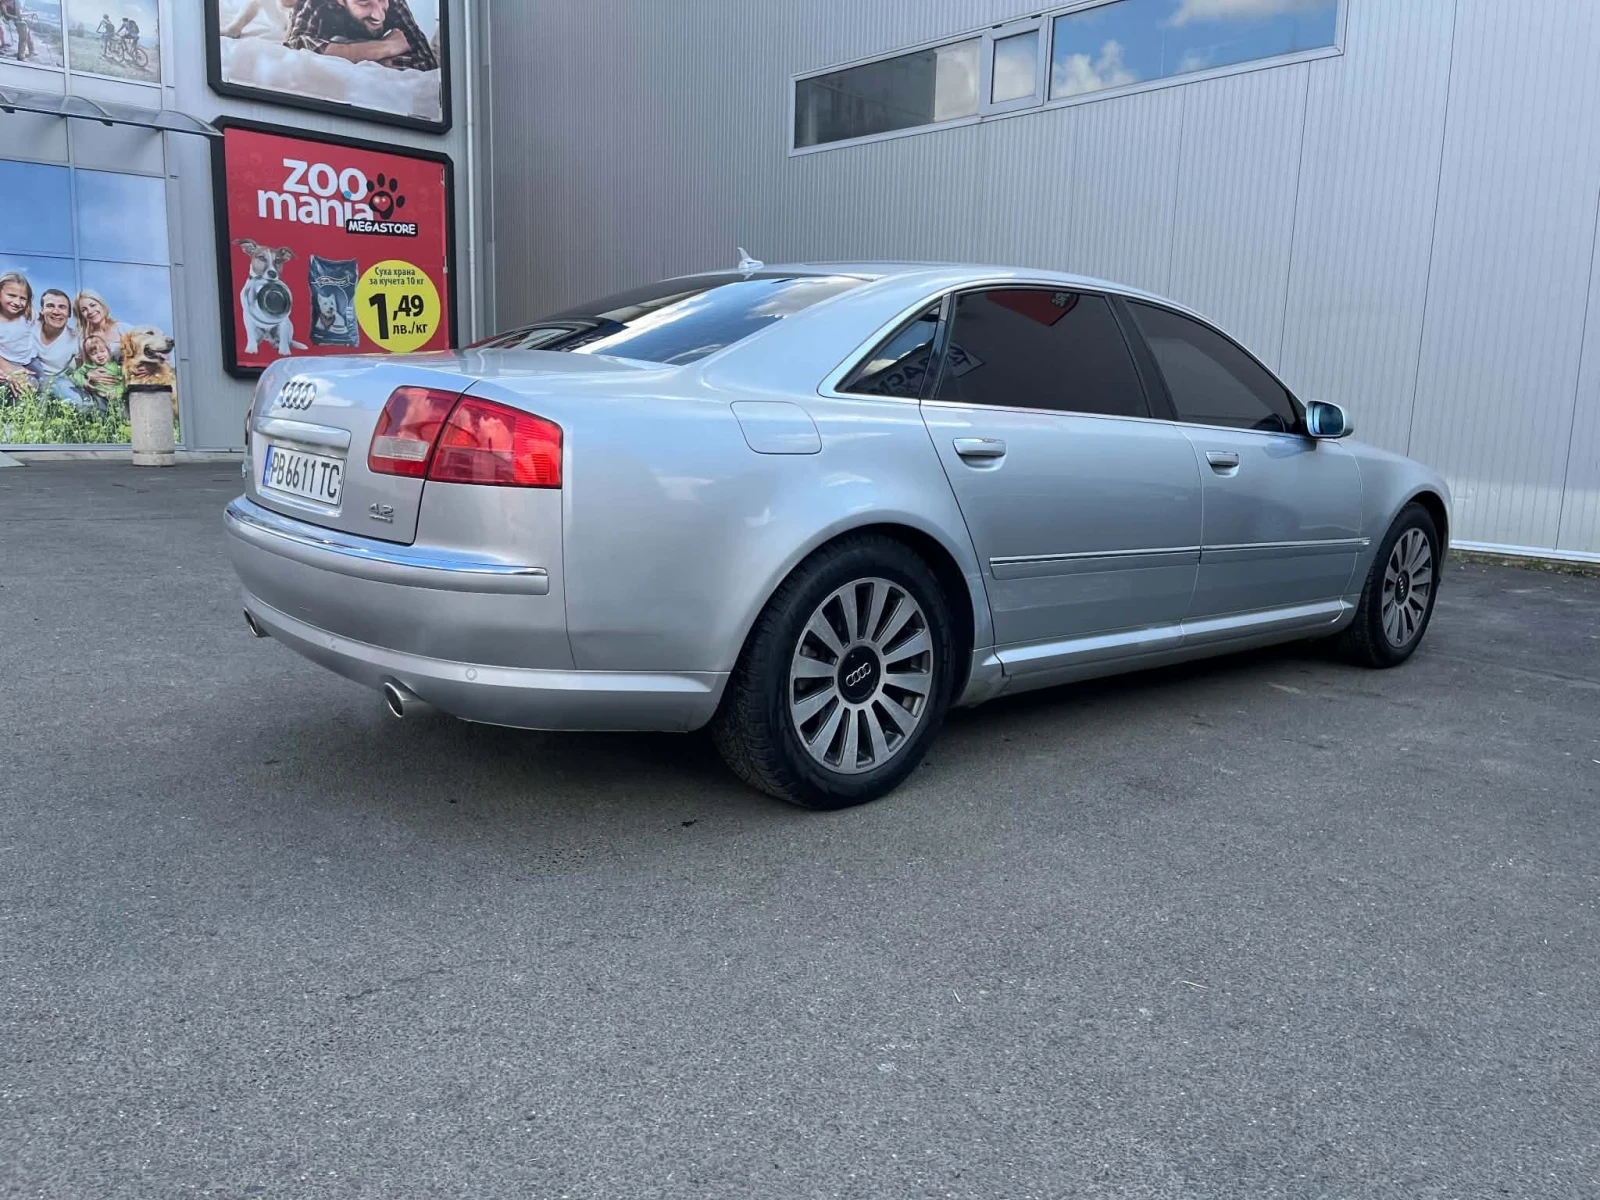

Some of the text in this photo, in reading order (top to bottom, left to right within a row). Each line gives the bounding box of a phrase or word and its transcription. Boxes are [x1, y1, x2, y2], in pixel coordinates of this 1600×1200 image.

[257, 188, 374, 228] mania
[348, 220, 416, 235] MEGASTORE
[374, 266, 416, 277] Суха храна
[379, 278, 405, 287] кучета
[406, 277, 415, 285] 10
[392, 321, 428, 335] лв./кг
